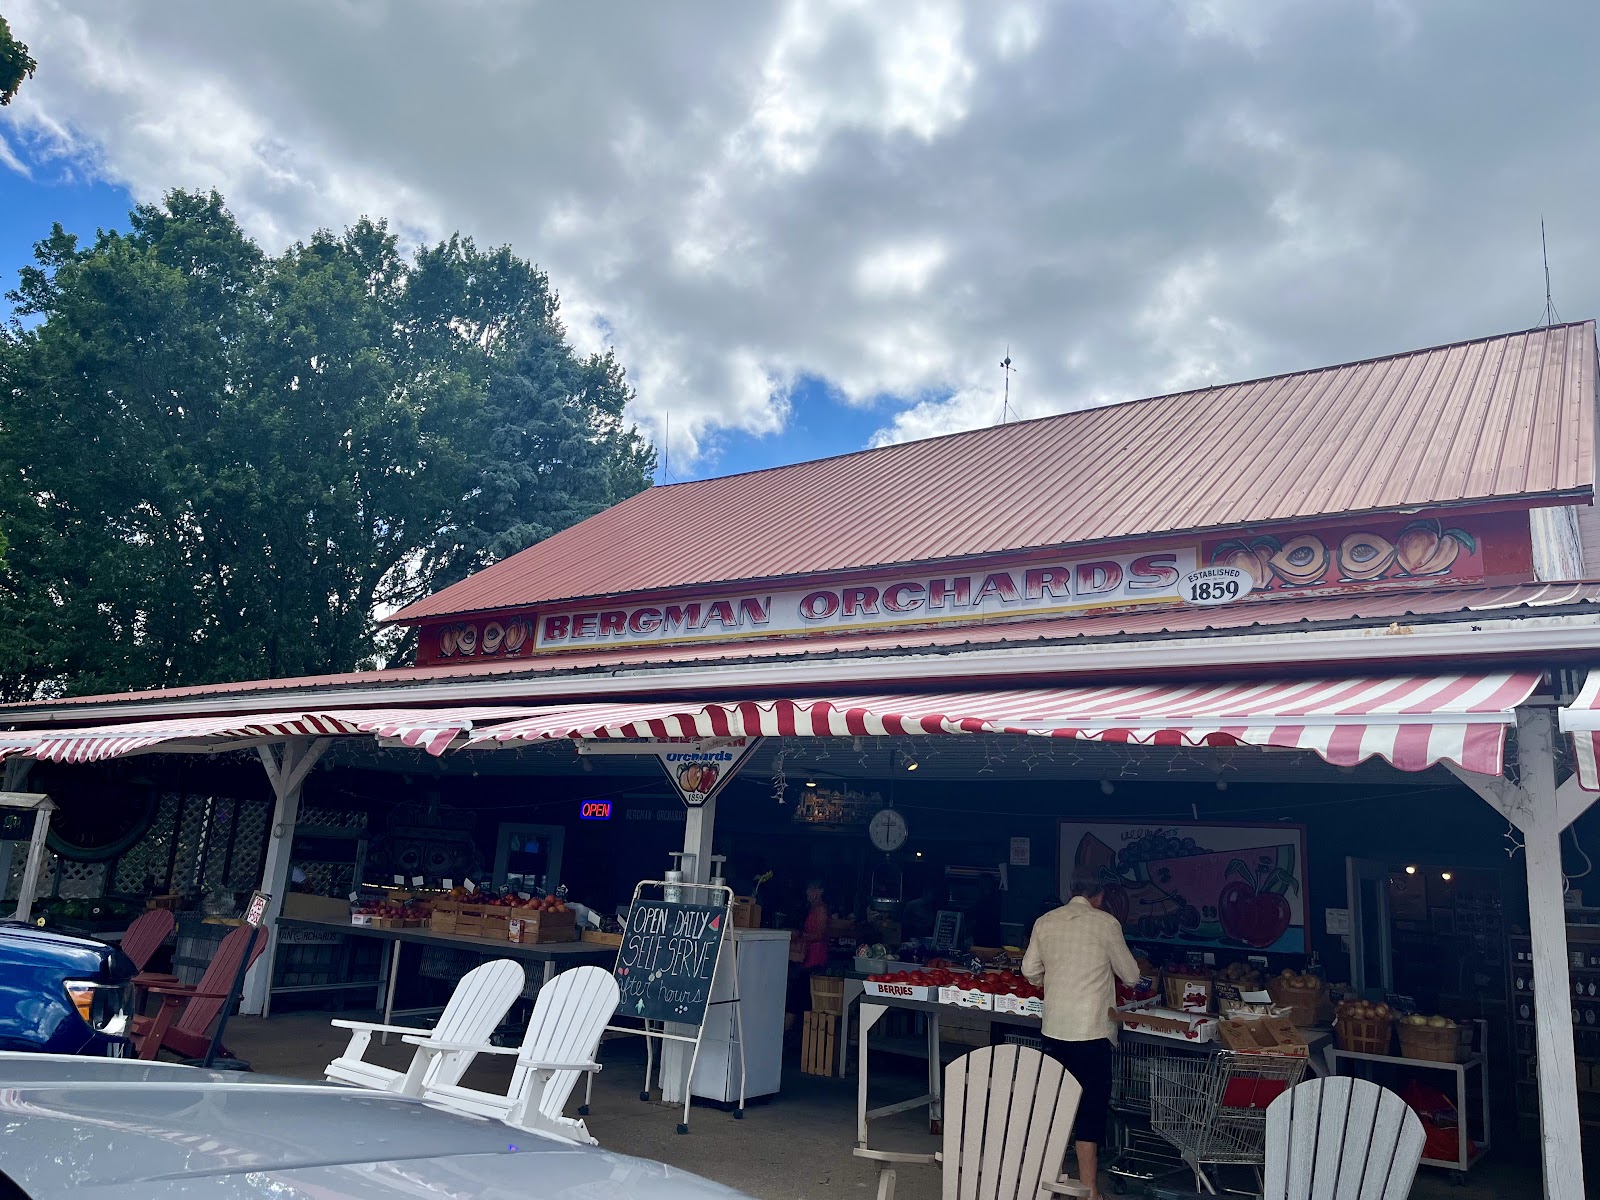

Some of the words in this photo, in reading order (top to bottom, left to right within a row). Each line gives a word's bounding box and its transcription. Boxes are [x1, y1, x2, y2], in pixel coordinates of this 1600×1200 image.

[1188, 569, 1240, 583] ESTABLISHED
[544, 596, 772, 641] BERGMAN
[799, 554, 1181, 620] ORCHARDS
[1191, 580, 1239, 601] 1859
[688, 793, 704, 802] 1859
[582, 803, 611, 817] OPEN
[625, 809, 653, 821] BERGMAN
[656, 810, 686, 822] ORCHARDS
[633, 906, 669, 934] OPEN
[673, 910, 710, 939] DAILY
[622, 935, 666, 971] SELF
[659, 938, 715, 979] SERVE
[617, 975, 651, 1005] after
[658, 980, 704, 1003] hours
[878, 984, 913, 996] BERRIES
